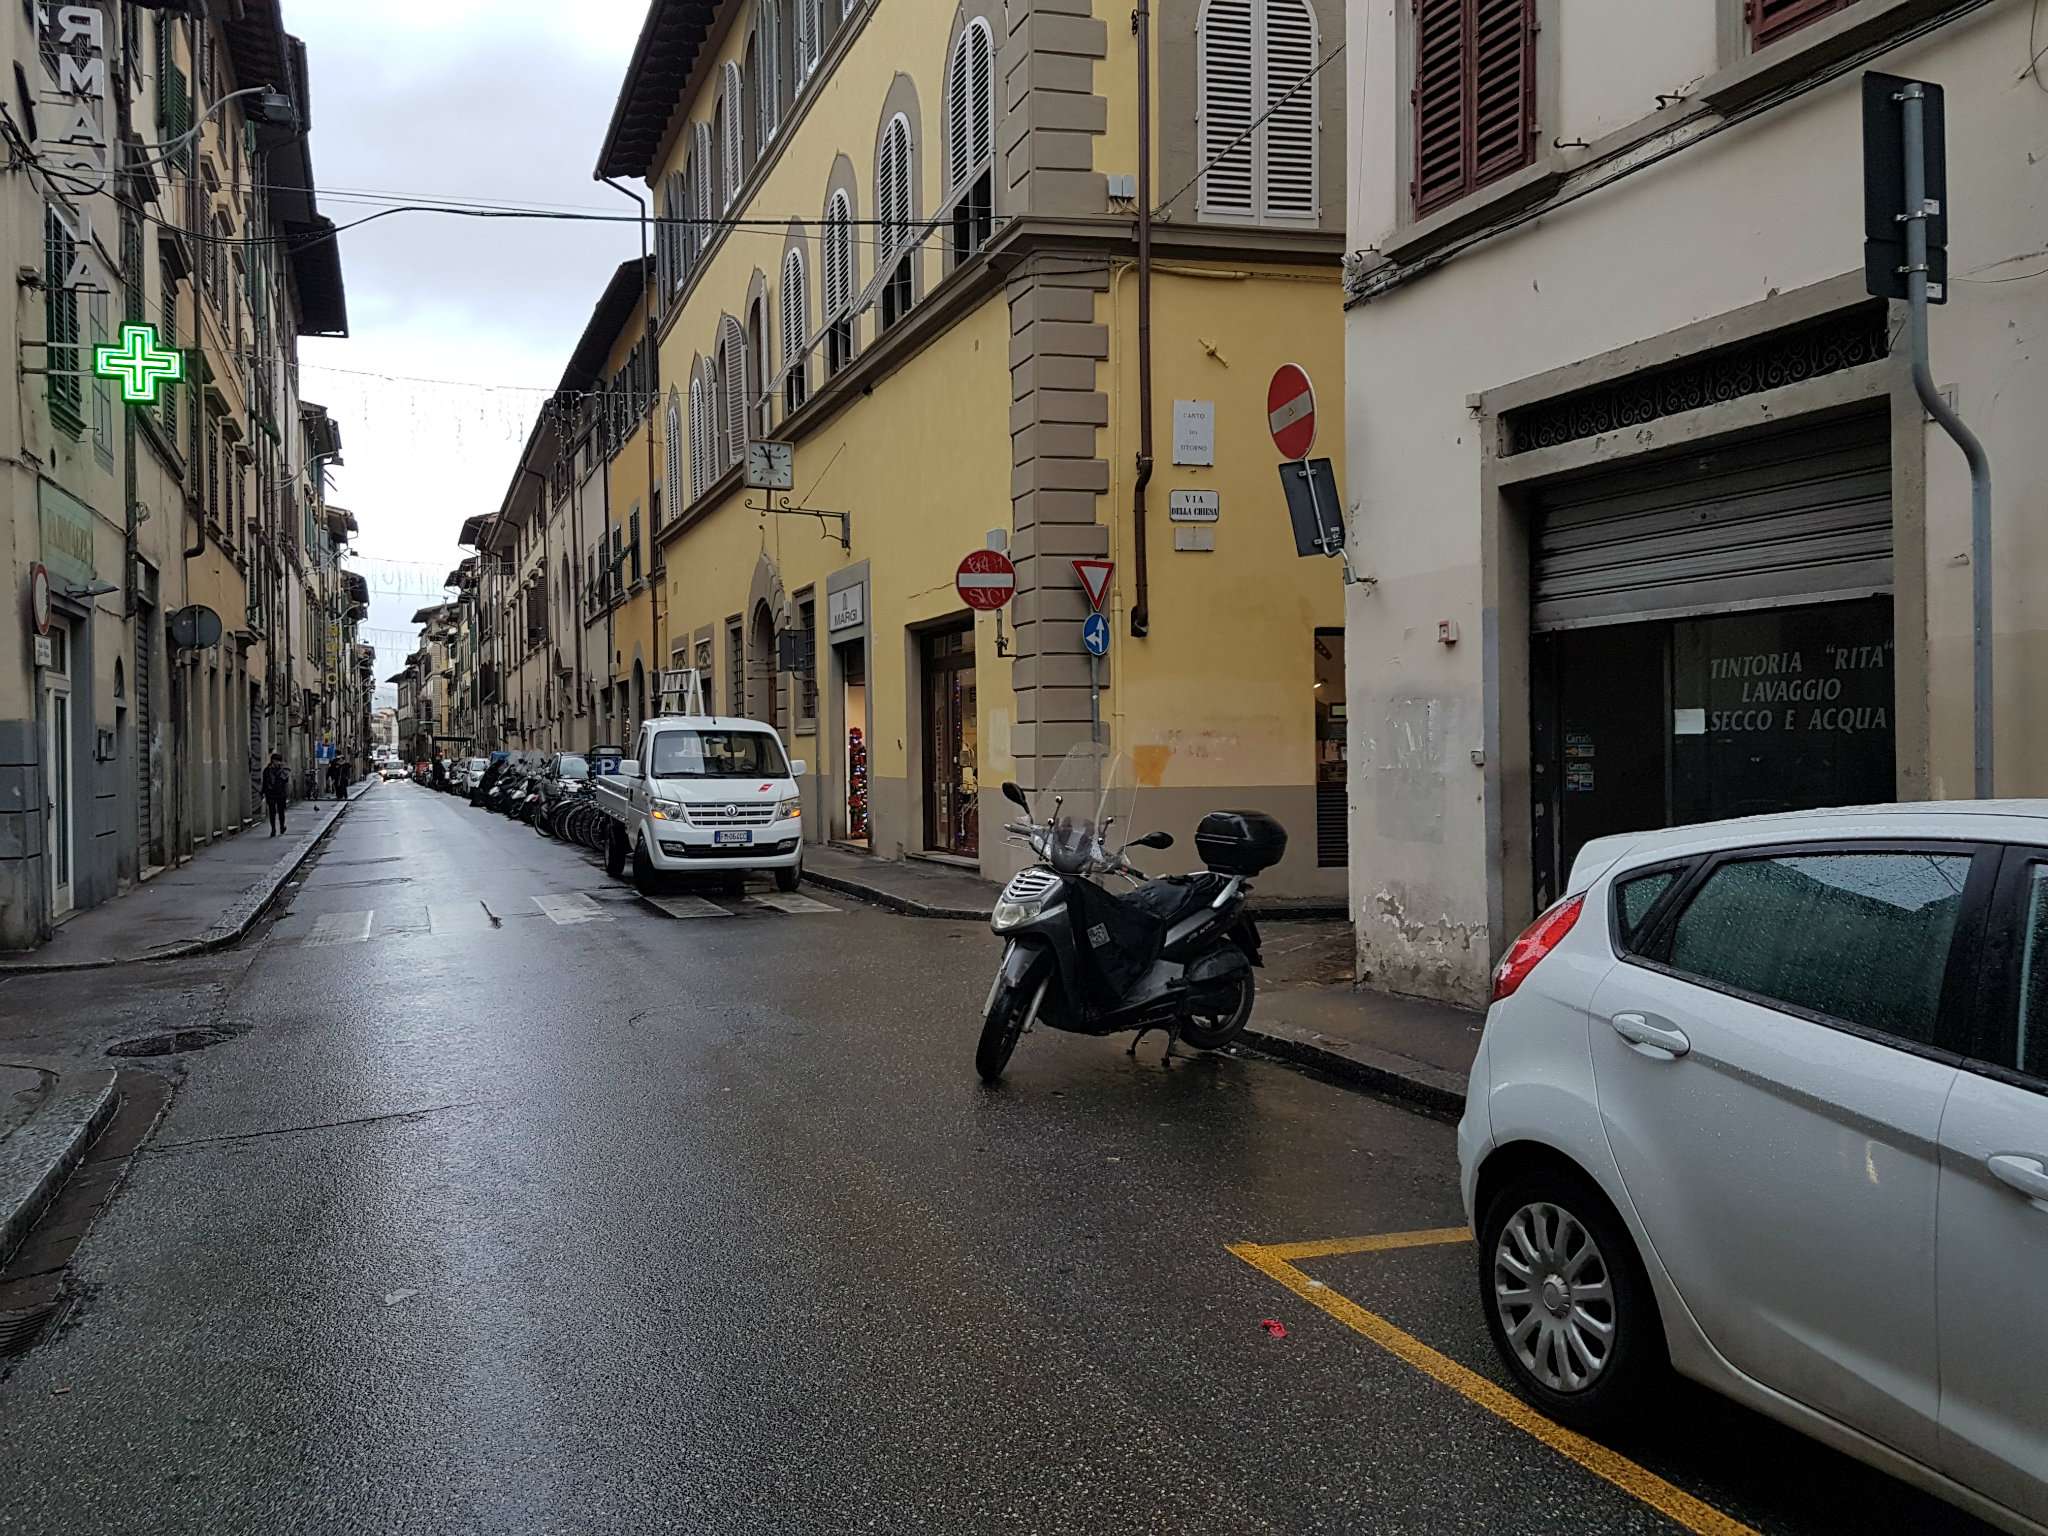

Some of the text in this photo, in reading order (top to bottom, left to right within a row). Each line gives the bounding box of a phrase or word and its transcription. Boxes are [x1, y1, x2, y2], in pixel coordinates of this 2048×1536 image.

[1185, 495, 1204, 504] VIA
[1171, 507, 1218, 516] DELLA CHIESA
[834, 608, 858, 626] MARGI
[1711, 651, 1802, 680] TINTORIA
[1742, 678, 1842, 703] LAVAGGIO
[1710, 707, 1888, 735] SECCO E ACQUA
[601, 759, 615, 775] P
